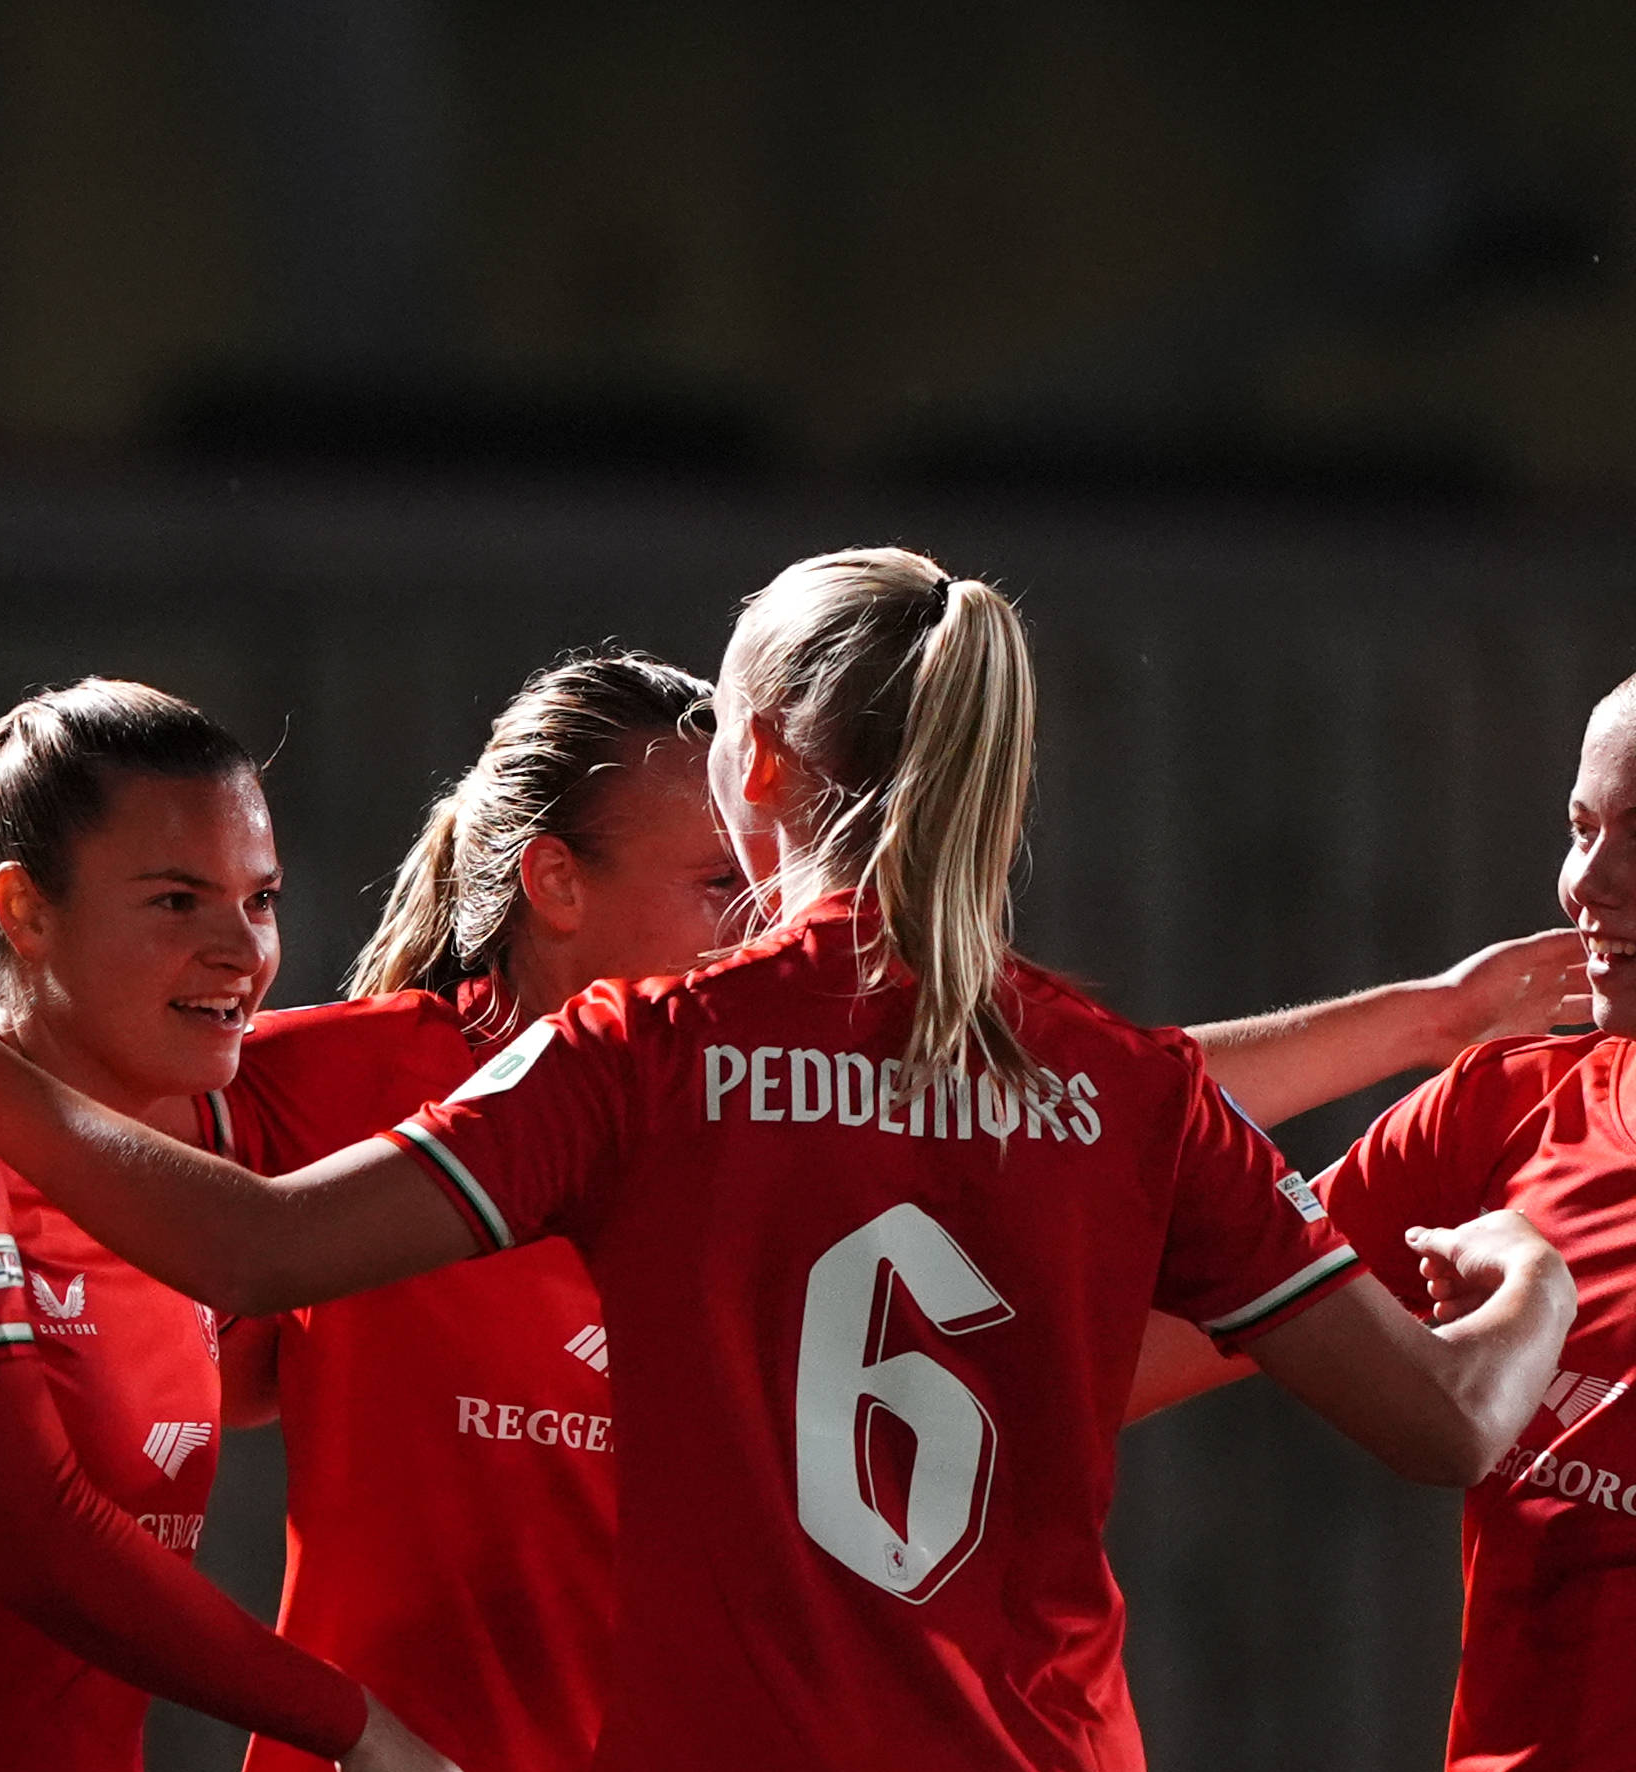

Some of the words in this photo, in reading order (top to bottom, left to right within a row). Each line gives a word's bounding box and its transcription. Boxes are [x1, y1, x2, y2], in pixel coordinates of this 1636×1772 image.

[704, 1044, 1102, 1146] PEDDEMORS
[40, 1323, 98, 1335] CASTORE
[456, 1396, 614, 1453] REGGE
[796, 1203, 1016, 1606] 6
